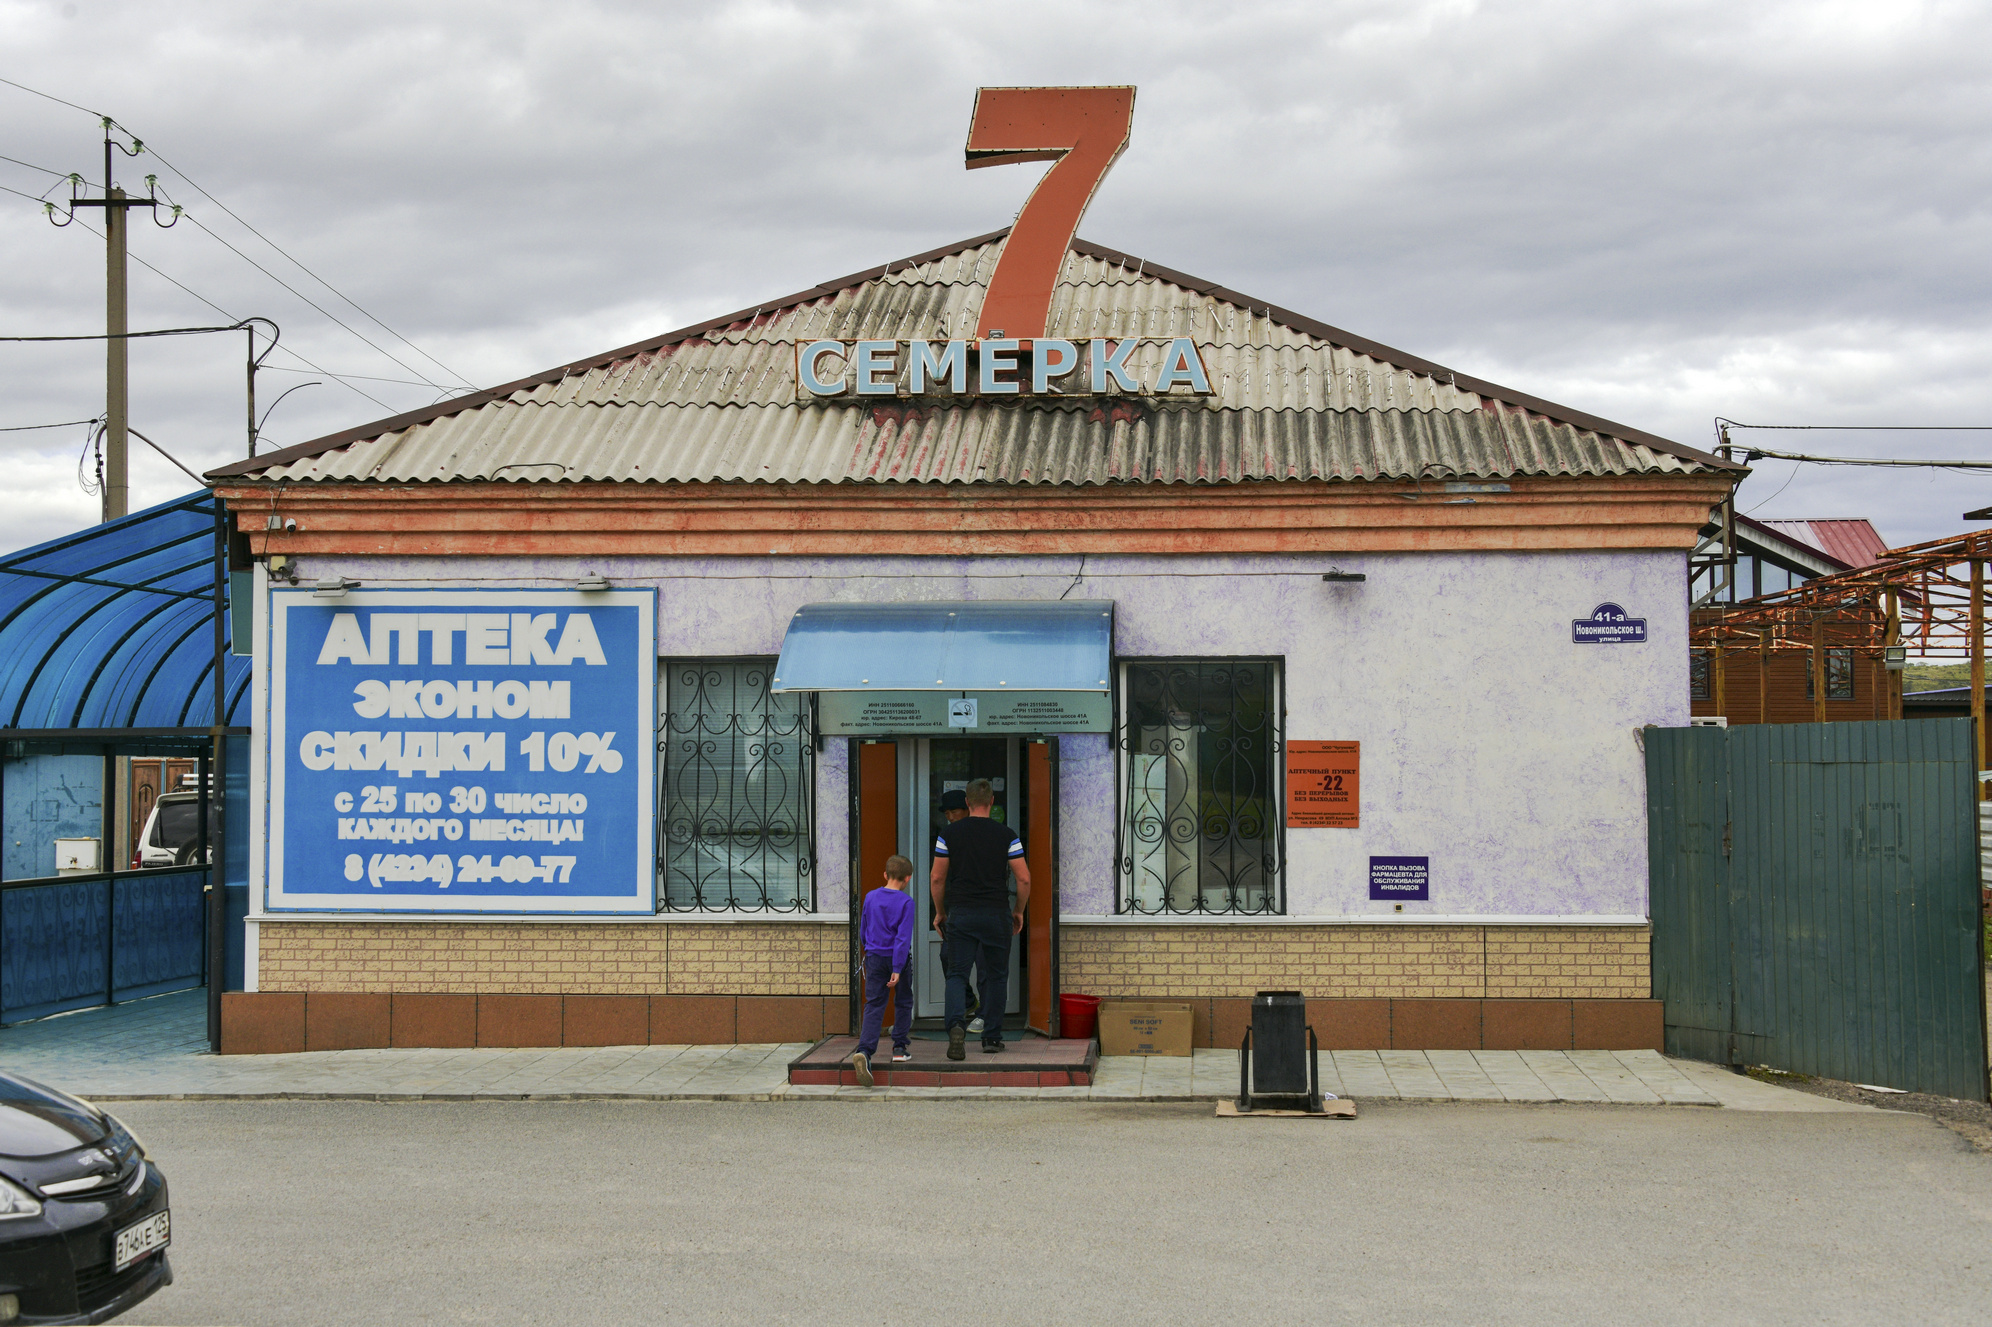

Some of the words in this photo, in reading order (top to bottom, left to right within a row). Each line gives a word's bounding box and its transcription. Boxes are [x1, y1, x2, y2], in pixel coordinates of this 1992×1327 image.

[965, 85, 1137, 345] 7
[800, 339, 1210, 395] СЕМЕРКА
[1576, 625, 1633, 634] Новоникольское
[1635, 626, 1643, 634] ш.
[1595, 612, 1624, 622] 41-а
[316, 613, 608, 665] АПТЕКА
[353, 680, 571, 719] ЭКОНОМ
[300, 731, 505, 778] СКИДКИ
[520, 731, 623, 773] 10%
[334, 791, 354, 813] с
[360, 785, 398, 813] 25
[404, 792, 442, 814] по
[449, 786, 487, 814] 30
[494, 793, 588, 814] число
[338, 818, 464, 844] КАЖДОГО
[469, 818, 584, 845] МЕСЯЦА!
[344, 853, 364, 882] 8
[368, 853, 454, 888] (4234)
